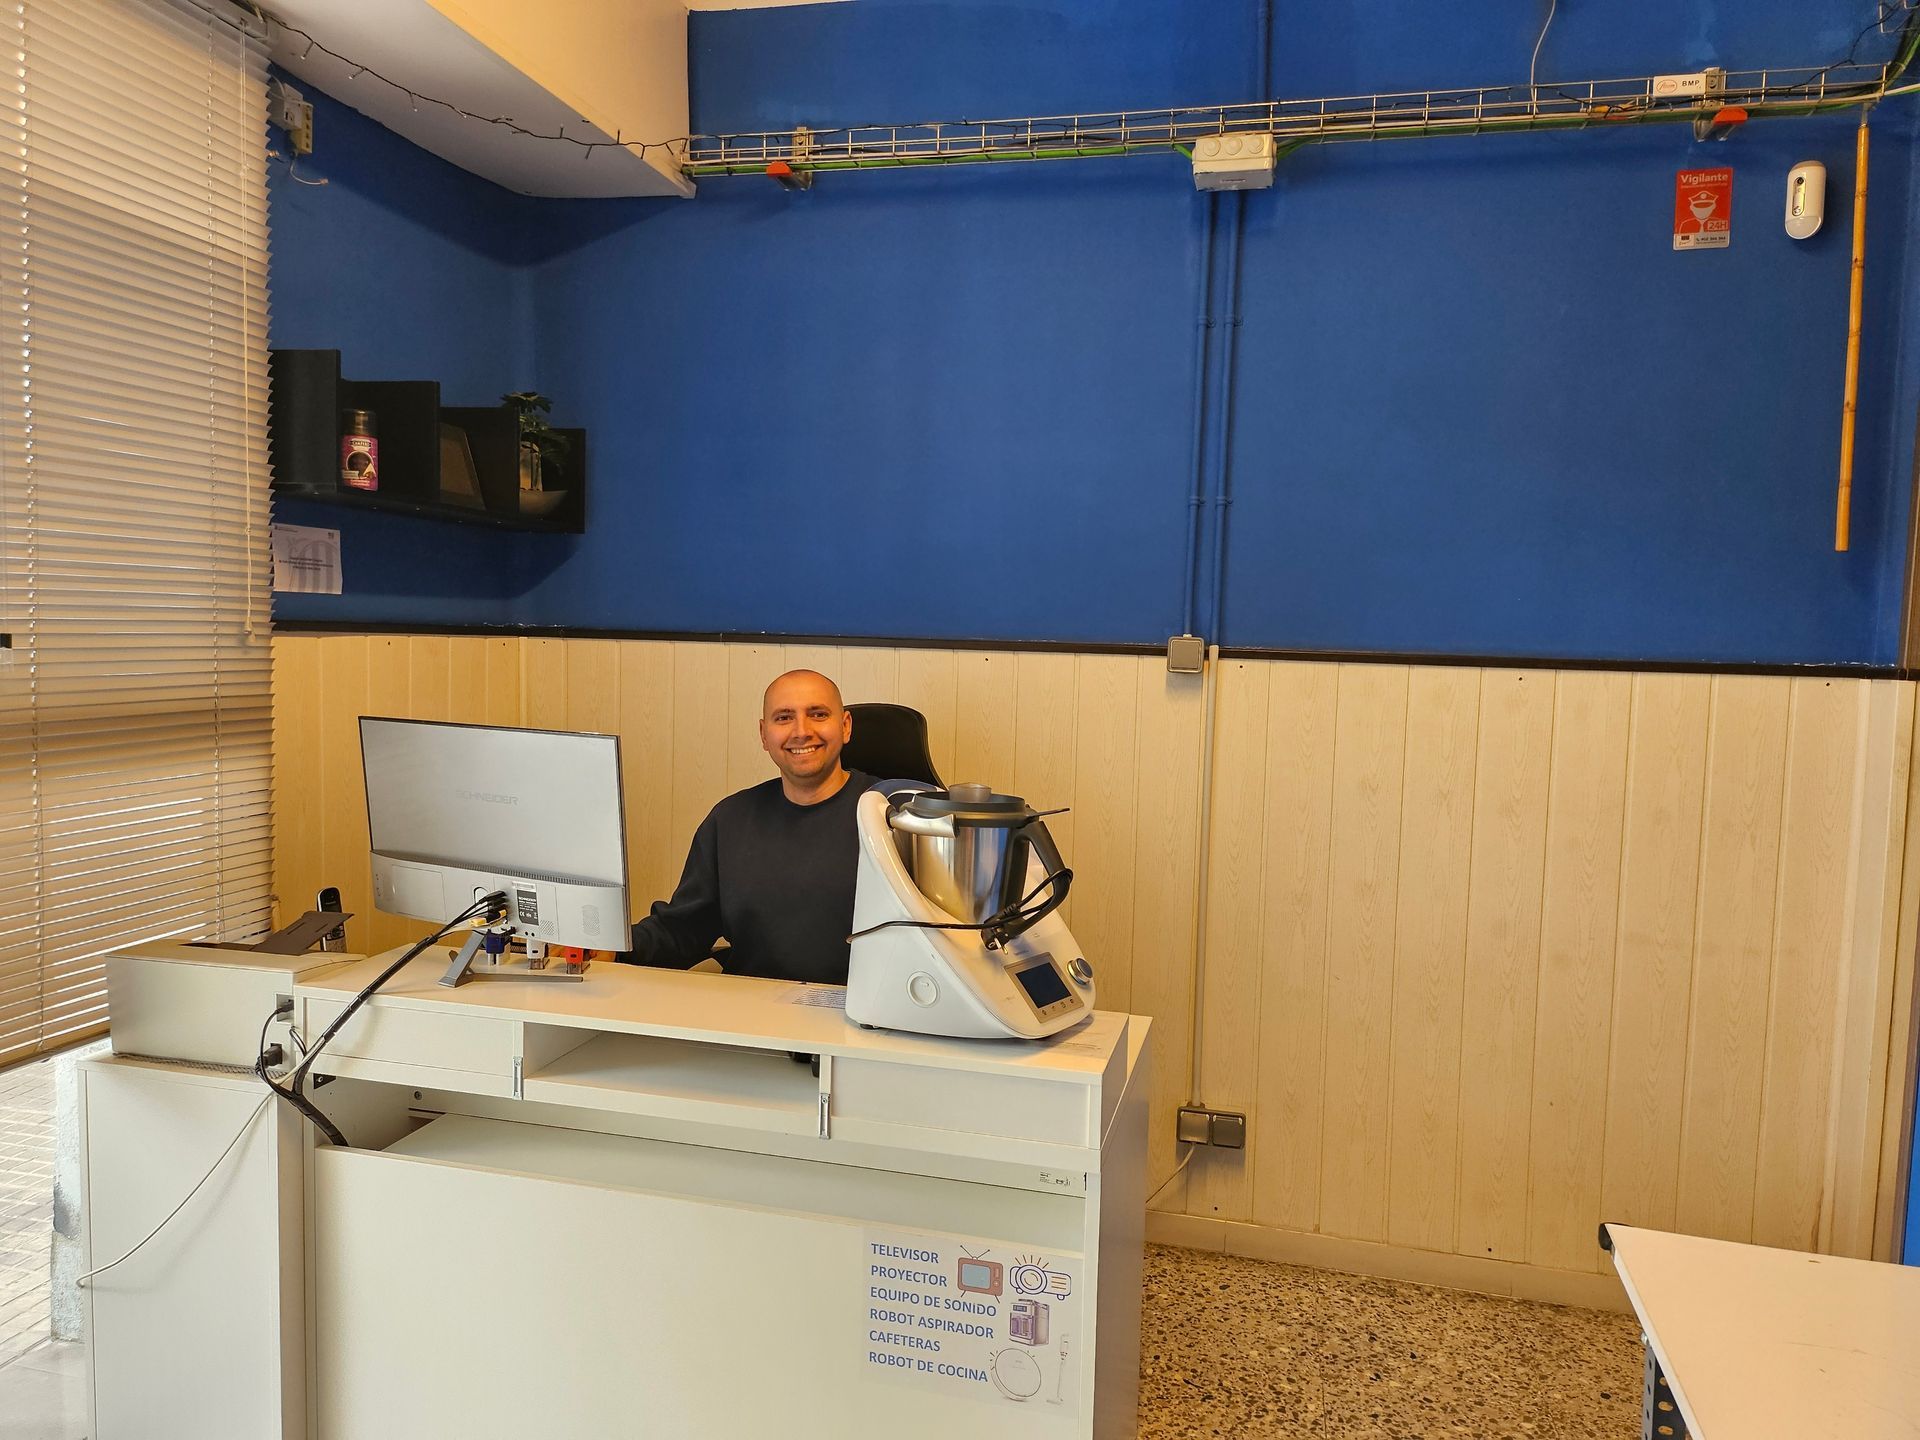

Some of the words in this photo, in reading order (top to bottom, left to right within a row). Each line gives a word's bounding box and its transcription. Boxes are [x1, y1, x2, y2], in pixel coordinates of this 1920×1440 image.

[1681, 173, 1728, 185] Vigilante
[1709, 221, 1727, 230] 24H
[871, 1243, 939, 1264] TELEVISOR
[871, 1265, 947, 1287] PROYECTOR
[870, 1287, 920, 1304] EQUIPO
[924, 1296, 941, 1308] DE
[944, 1299, 997, 1317] SONIDO
[870, 1308, 915, 1326] ROBOT
[918, 1316, 994, 1339] ASPIRADOR
[869, 1330, 941, 1352] CAFETERAS
[869, 1352, 914, 1369] ROBOT
[917, 1360, 934, 1373] DE
[937, 1363, 988, 1383] COCINA
